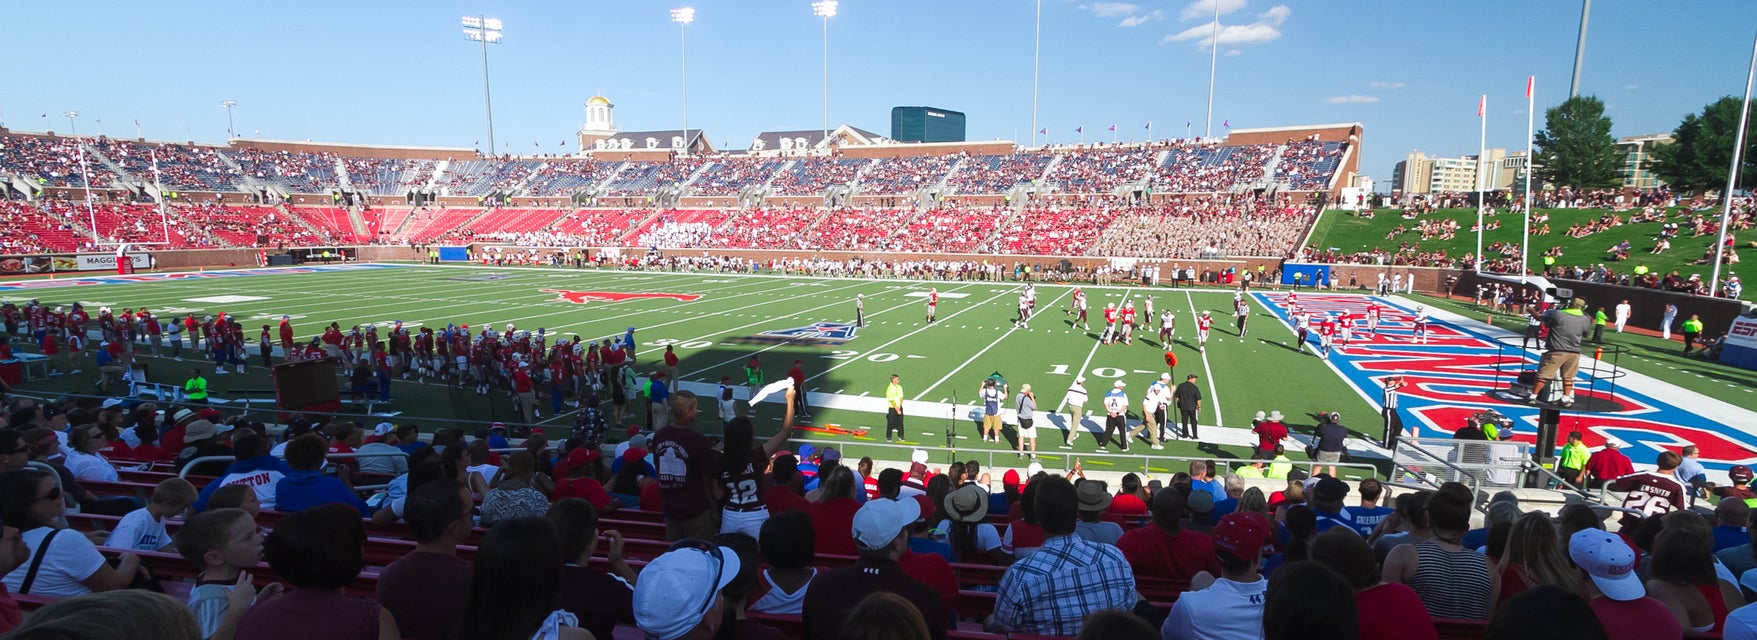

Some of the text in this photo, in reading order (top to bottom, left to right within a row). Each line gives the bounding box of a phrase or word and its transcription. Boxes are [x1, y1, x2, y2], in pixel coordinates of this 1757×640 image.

[86, 255, 142, 264] MAGGI'S
[820, 350, 899, 362] 20
[1044, 364, 1127, 378] 10
[226, 472, 271, 487] TTON
[726, 479, 759, 505] 12
[1625, 490, 1671, 518] 26
